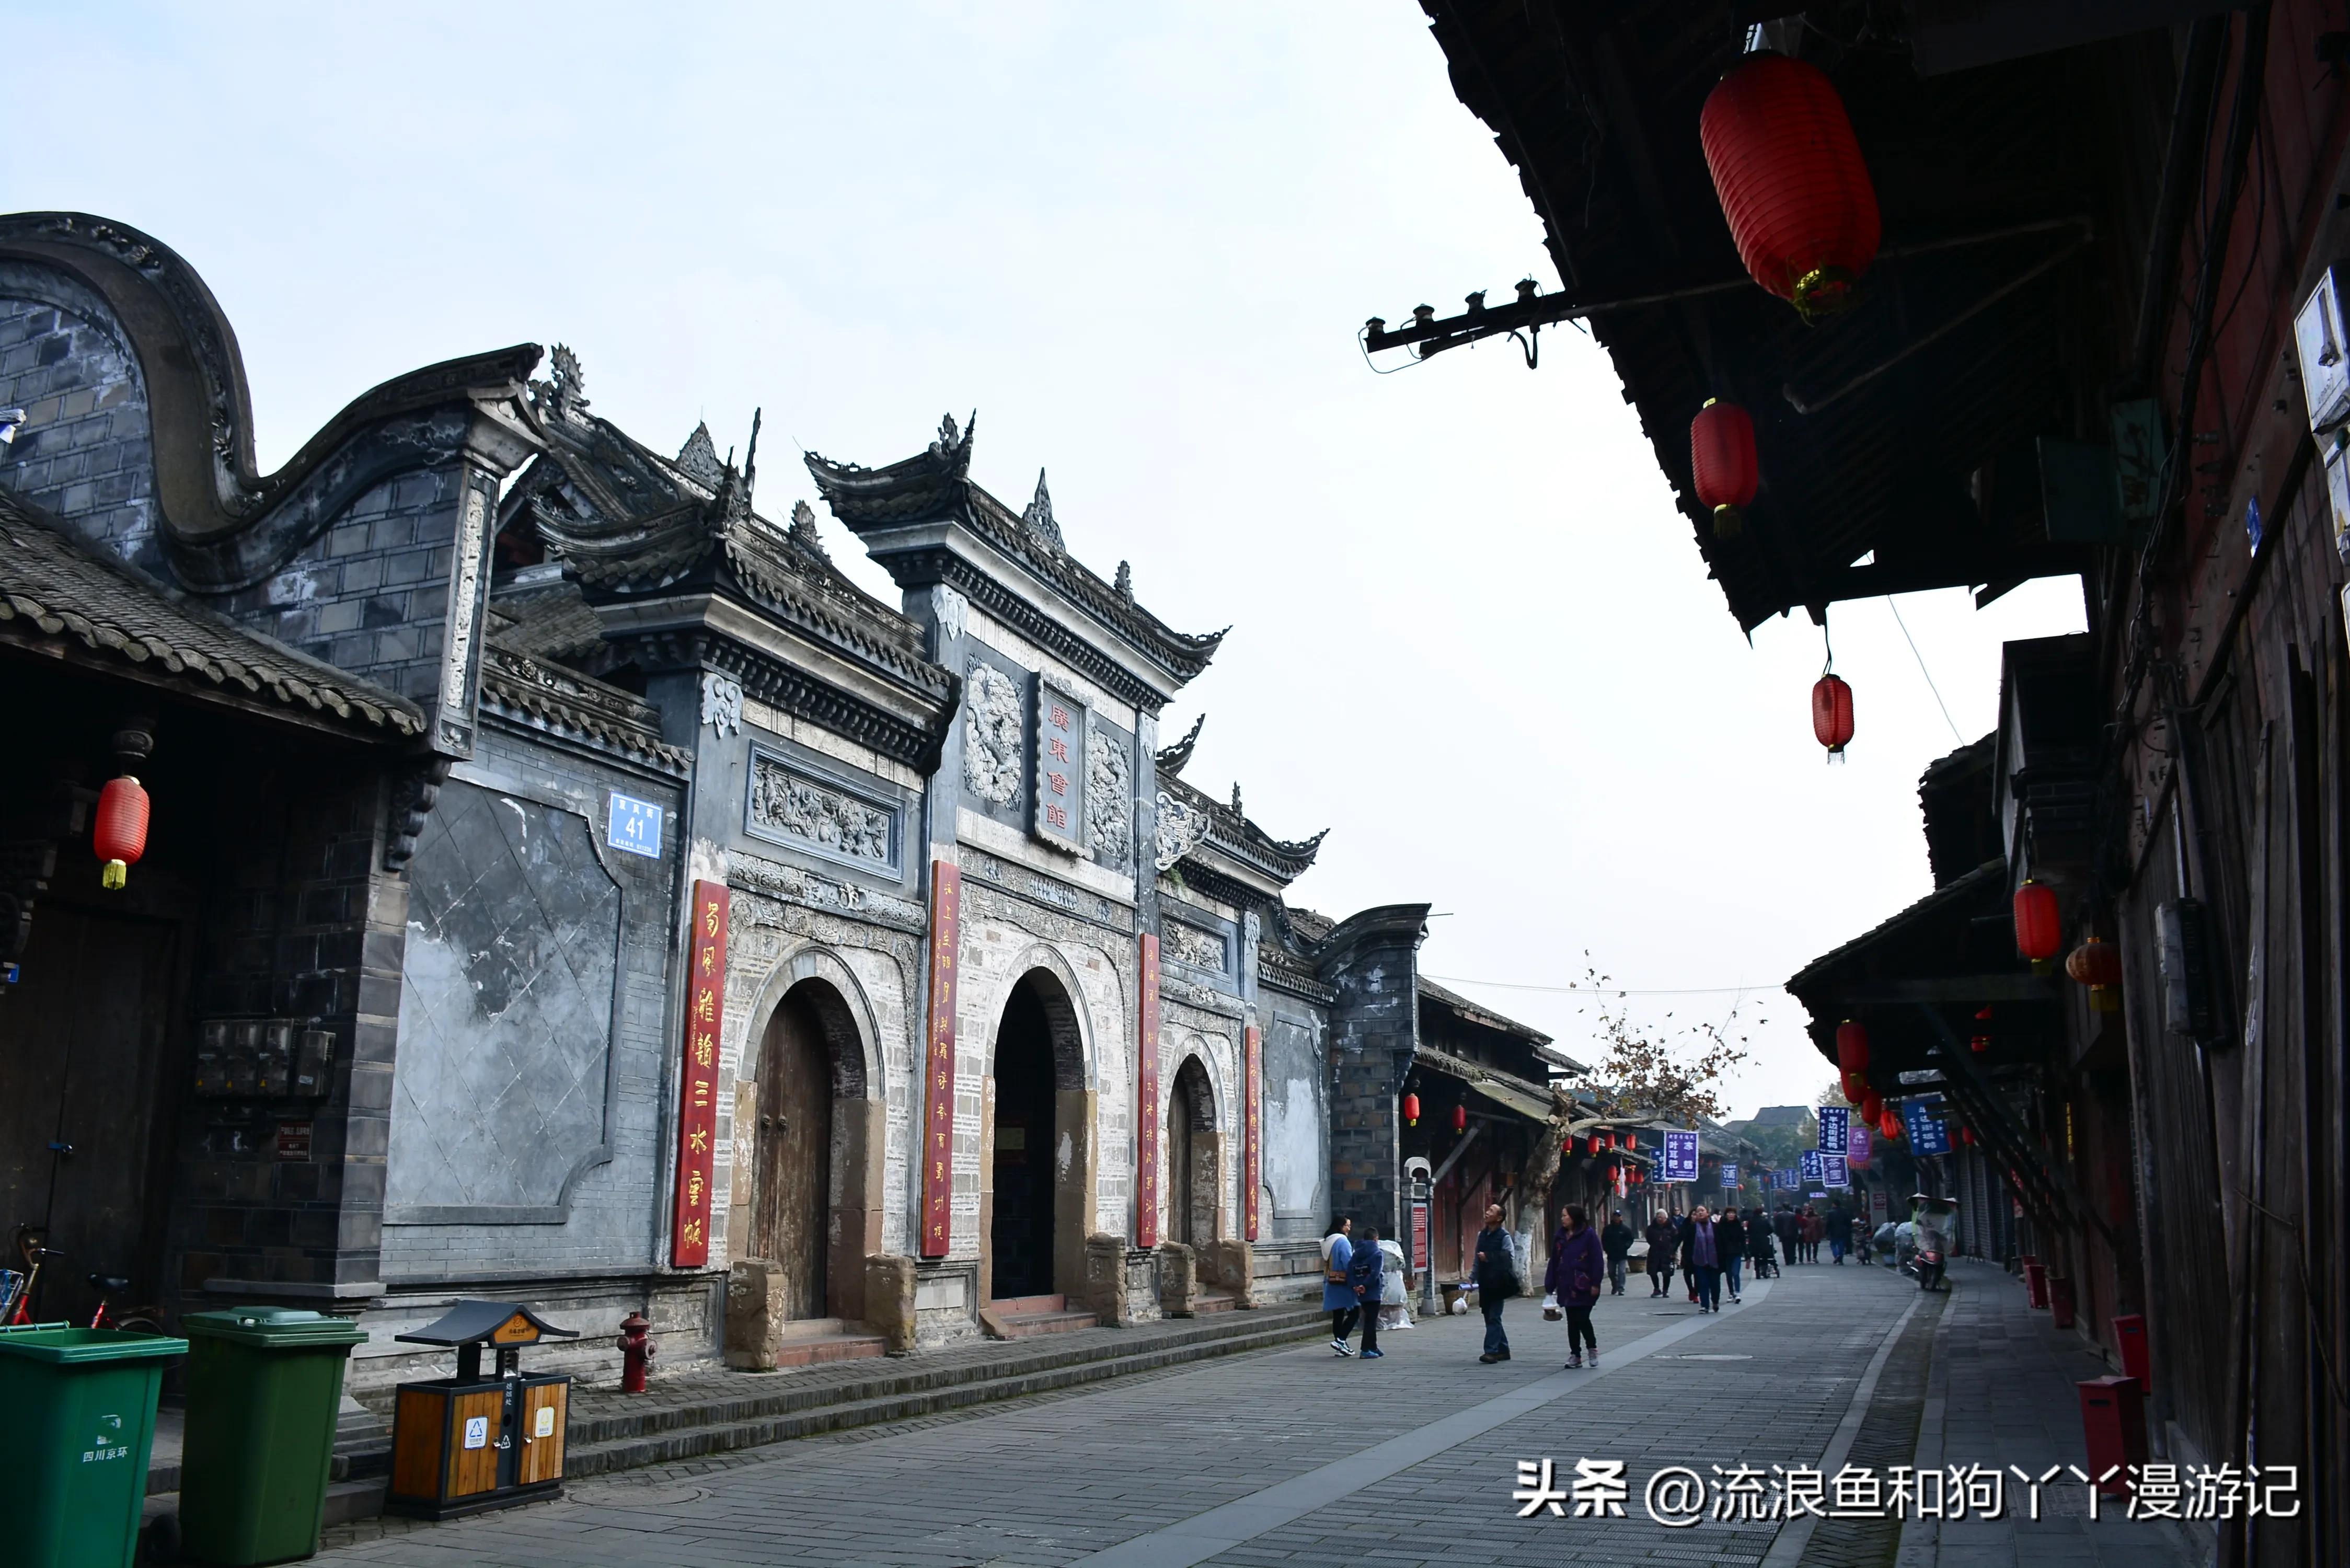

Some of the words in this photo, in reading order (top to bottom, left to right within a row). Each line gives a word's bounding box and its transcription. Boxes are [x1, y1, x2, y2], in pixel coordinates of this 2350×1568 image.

[1047, 704, 1070, 829] 廣東會館
[625, 817, 644, 841] 41
[83, 1447, 128, 1463] 四川京环
